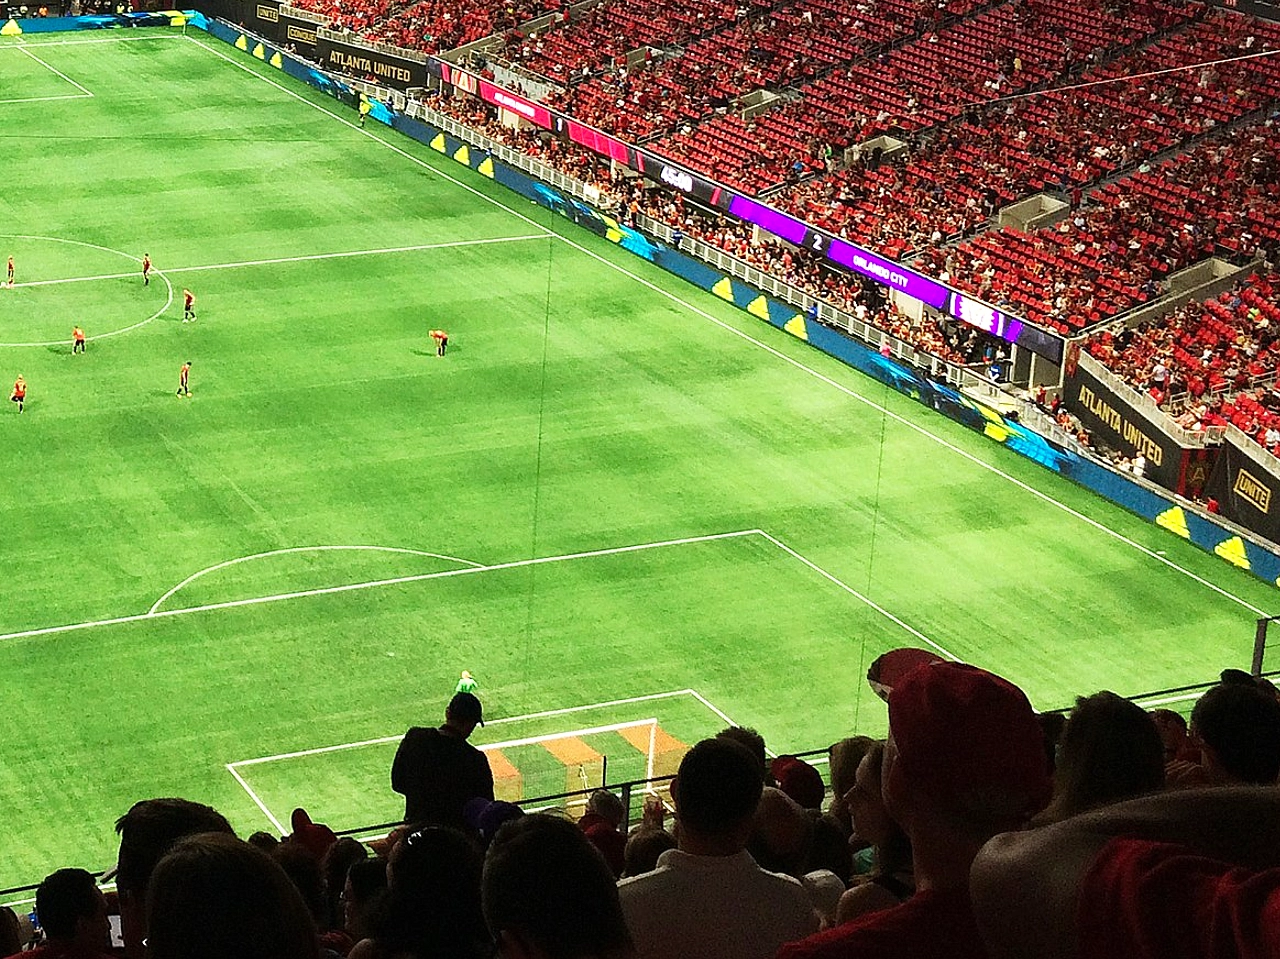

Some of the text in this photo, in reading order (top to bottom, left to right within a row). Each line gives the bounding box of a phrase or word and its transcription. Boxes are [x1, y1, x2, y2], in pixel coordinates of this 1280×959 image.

[259, 7, 278, 20] UNITE
[329, 50, 411, 83] ATLANTA UNITED
[812, 232, 822, 249] 2
[853, 255, 909, 288] ORLANDO CITY
[1079, 384, 1163, 467] ATLANTA UNITED
[1240, 475, 1267, 506] UNITE
